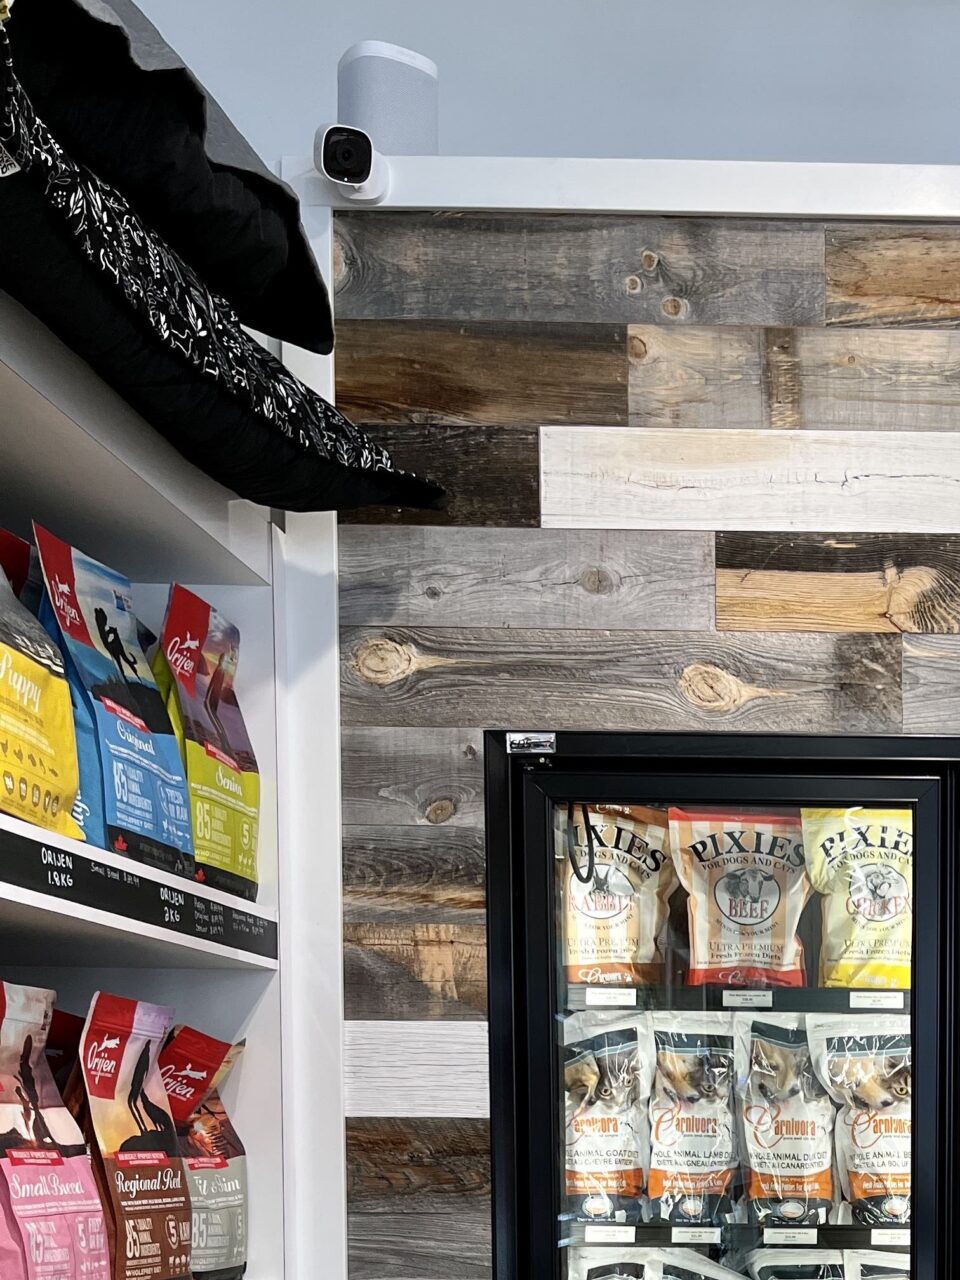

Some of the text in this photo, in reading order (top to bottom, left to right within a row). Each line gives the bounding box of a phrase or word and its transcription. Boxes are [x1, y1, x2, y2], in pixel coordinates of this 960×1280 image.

[167, 638, 195, 675] Orijen
[116, 720, 155, 755] Original
[113, 760, 128, 802] 85
[196, 801, 211, 840] 85
[41, 847, 73, 870] ORIJEN
[571, 824, 668, 873] IXIES
[688, 830, 805, 867] PIXIES
[820, 826, 913, 865] PIXIE
[48, 871, 73, 887] 1.8KG
[702, 856, 797, 874] FOR DOGS AND CATS
[160, 887, 184, 905] ORIJEN
[729, 898, 769, 919] BEEF
[164, 907, 180, 922] 2KG
[708, 941, 784, 951] ULTRA PREMIUM
[762, 952, 781, 960] Diets
[87, 1042, 116, 1084] Orijen
[160, 1064, 195, 1100] Orijen
[704, 1151, 723, 1159] LAMB
[10, 1173, 50, 1200] Small
[116, 1168, 181, 1198] Regional Red
[125, 1219, 140, 1258] 85
